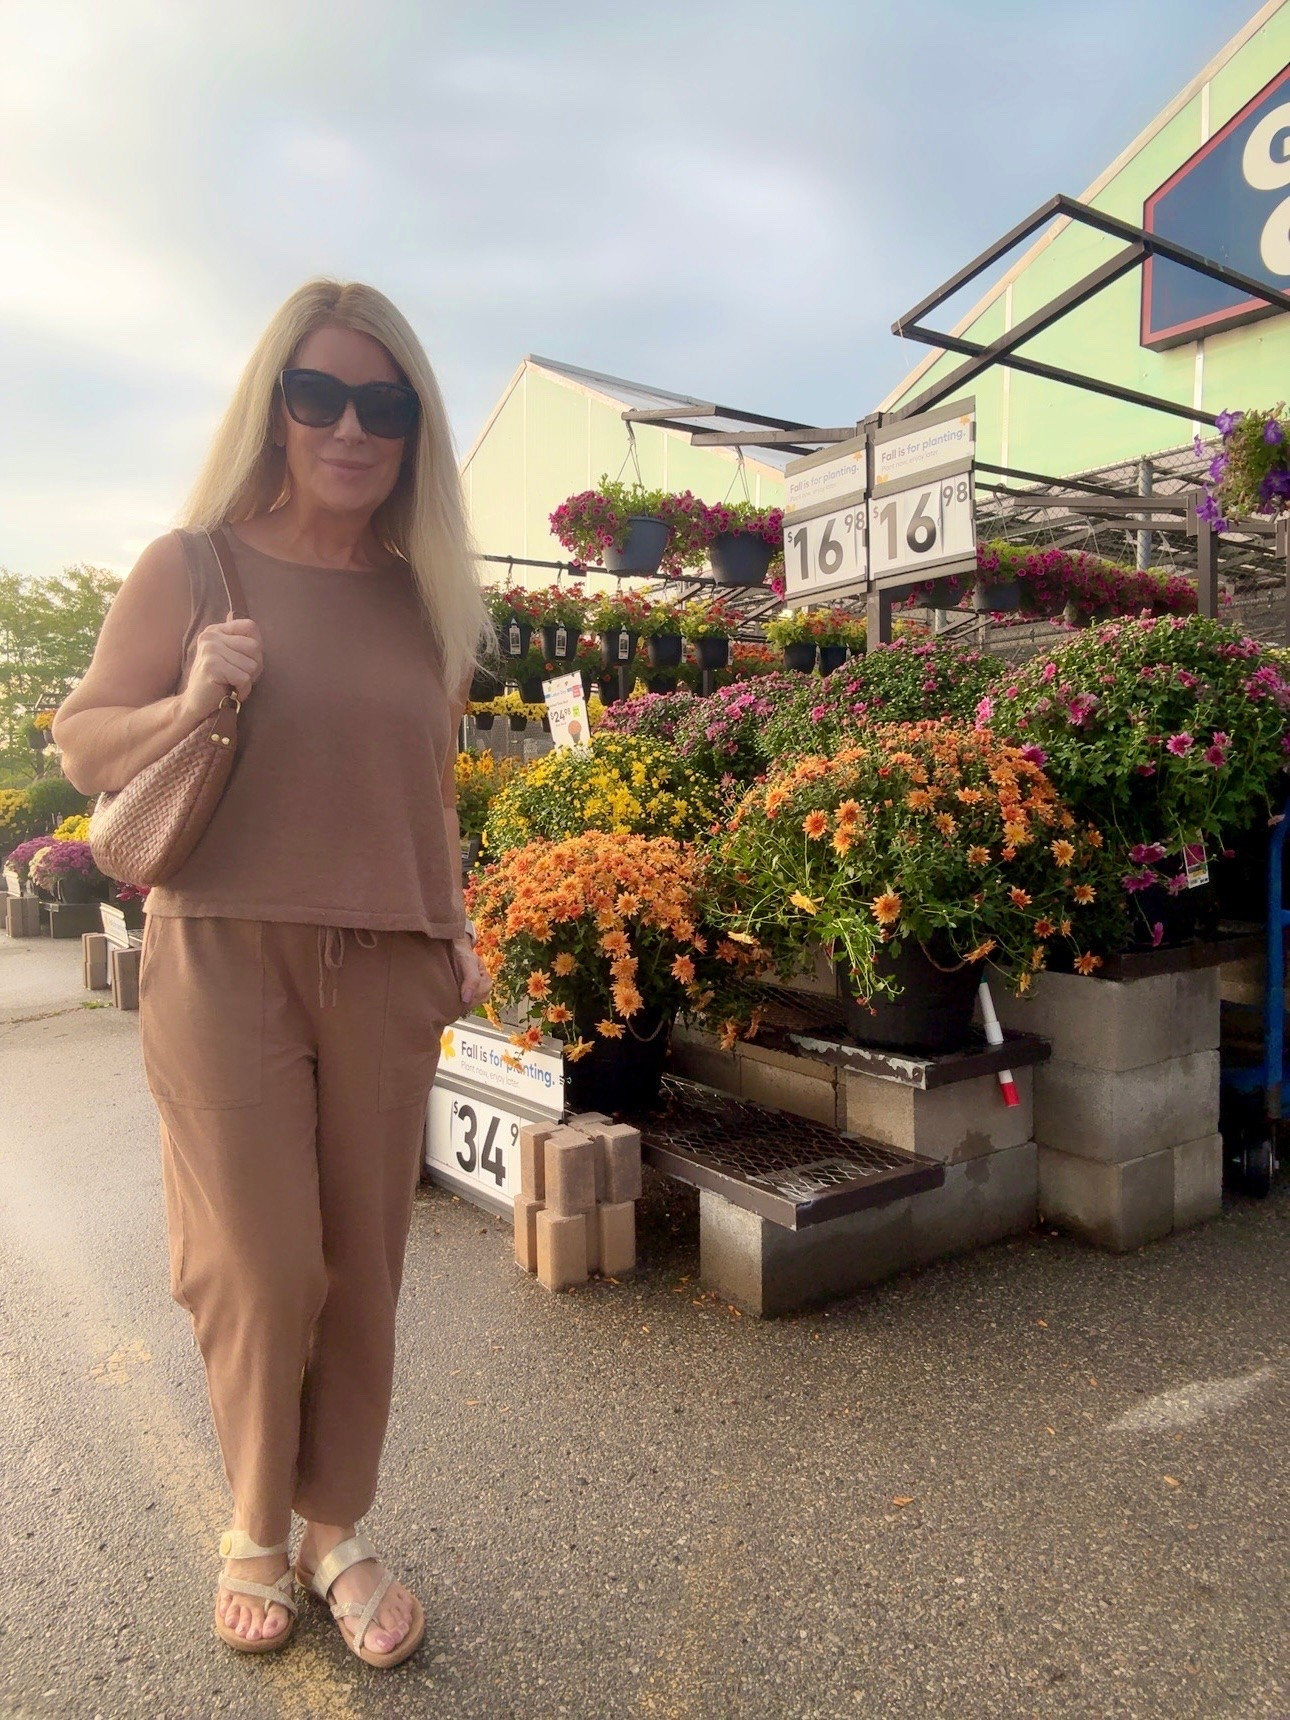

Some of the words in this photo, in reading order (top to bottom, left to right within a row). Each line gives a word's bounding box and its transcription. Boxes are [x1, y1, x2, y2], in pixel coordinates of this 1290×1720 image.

[881, 448, 897, 463] Fall
[898, 446, 906, 457] is
[907, 442, 920, 454] for
[922, 429, 966, 452] planting.
[790, 480, 803, 494] Fall
[803, 479, 810, 489] is
[811, 475, 822, 486] for
[823, 464, 859, 484] planting.
[461, 1040, 478, 1060] Fall
[479, 1046, 488, 1063] is
[489, 1049, 503, 1068] for
[506, 1062, 555, 1088] pnting.
